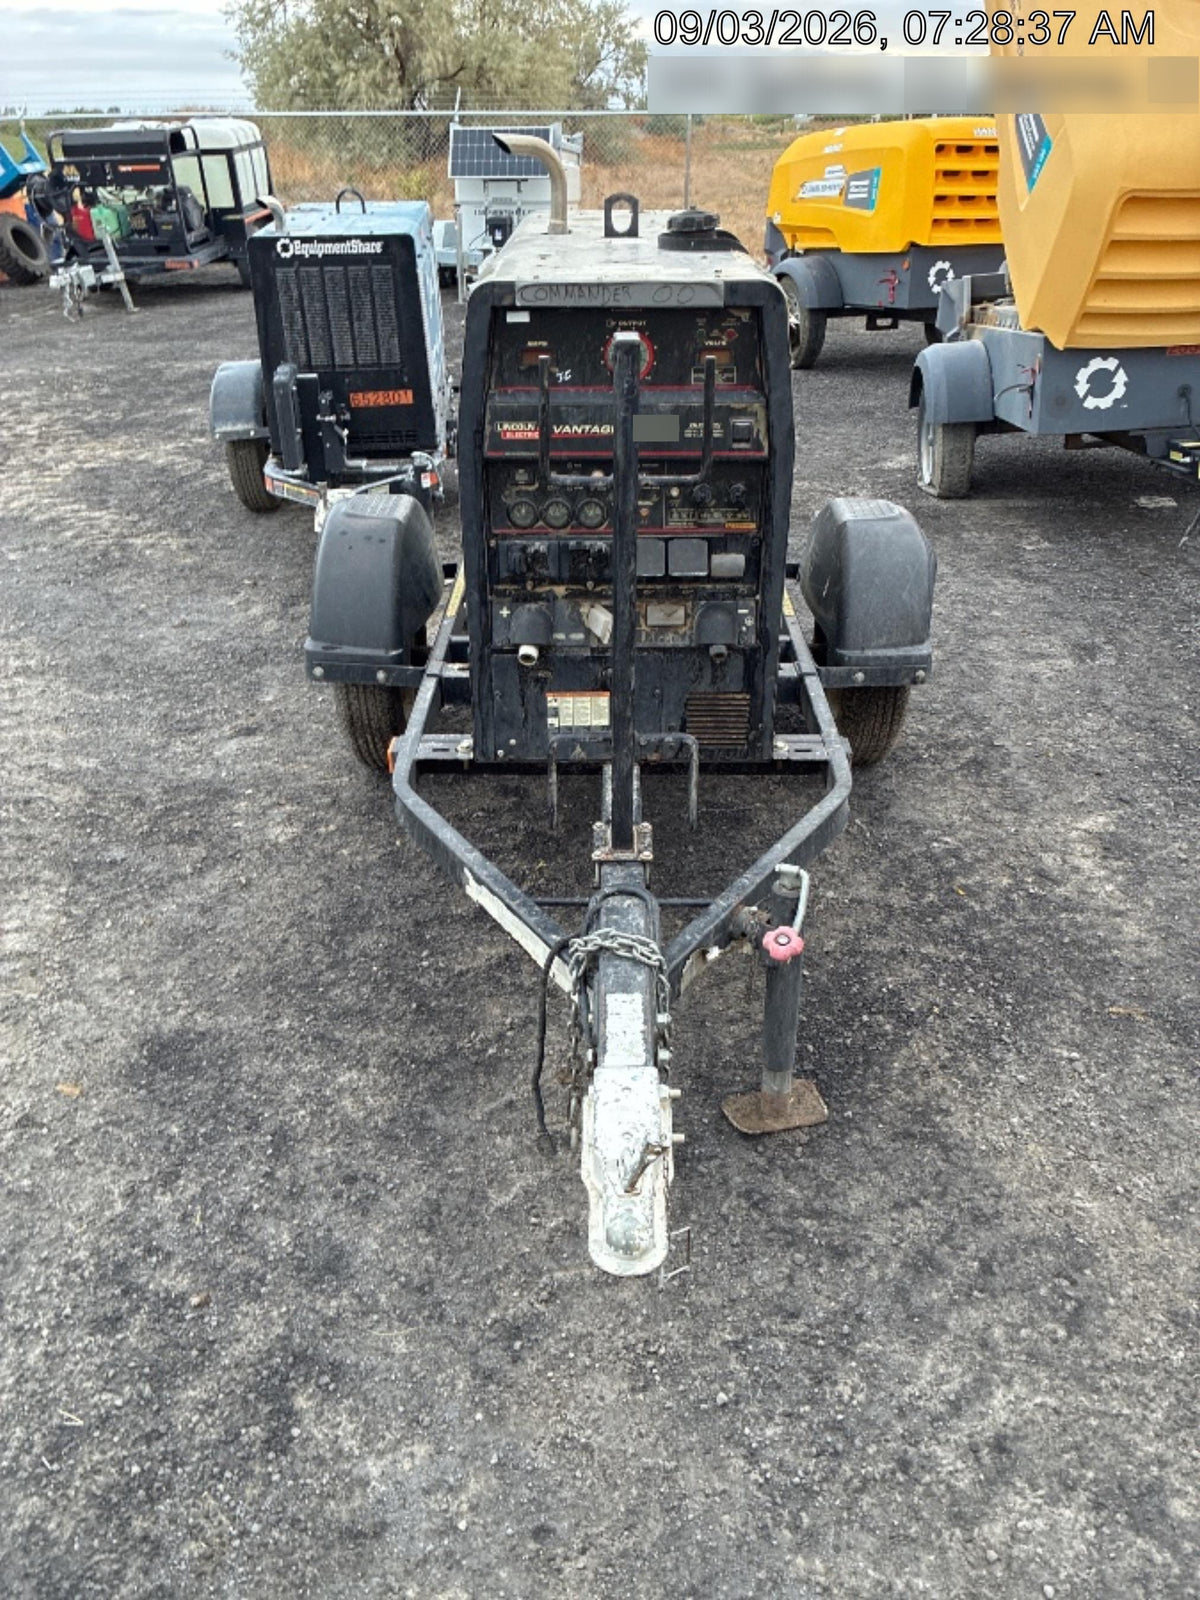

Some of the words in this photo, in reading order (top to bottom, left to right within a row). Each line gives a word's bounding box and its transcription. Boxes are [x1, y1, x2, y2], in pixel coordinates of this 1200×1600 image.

[293, 239, 384, 259] EquipmentShare
[520, 284, 632, 305] COMMANDER
[497, 421, 536, 431] LINCOLN
[552, 424, 614, 435] VANTAG
